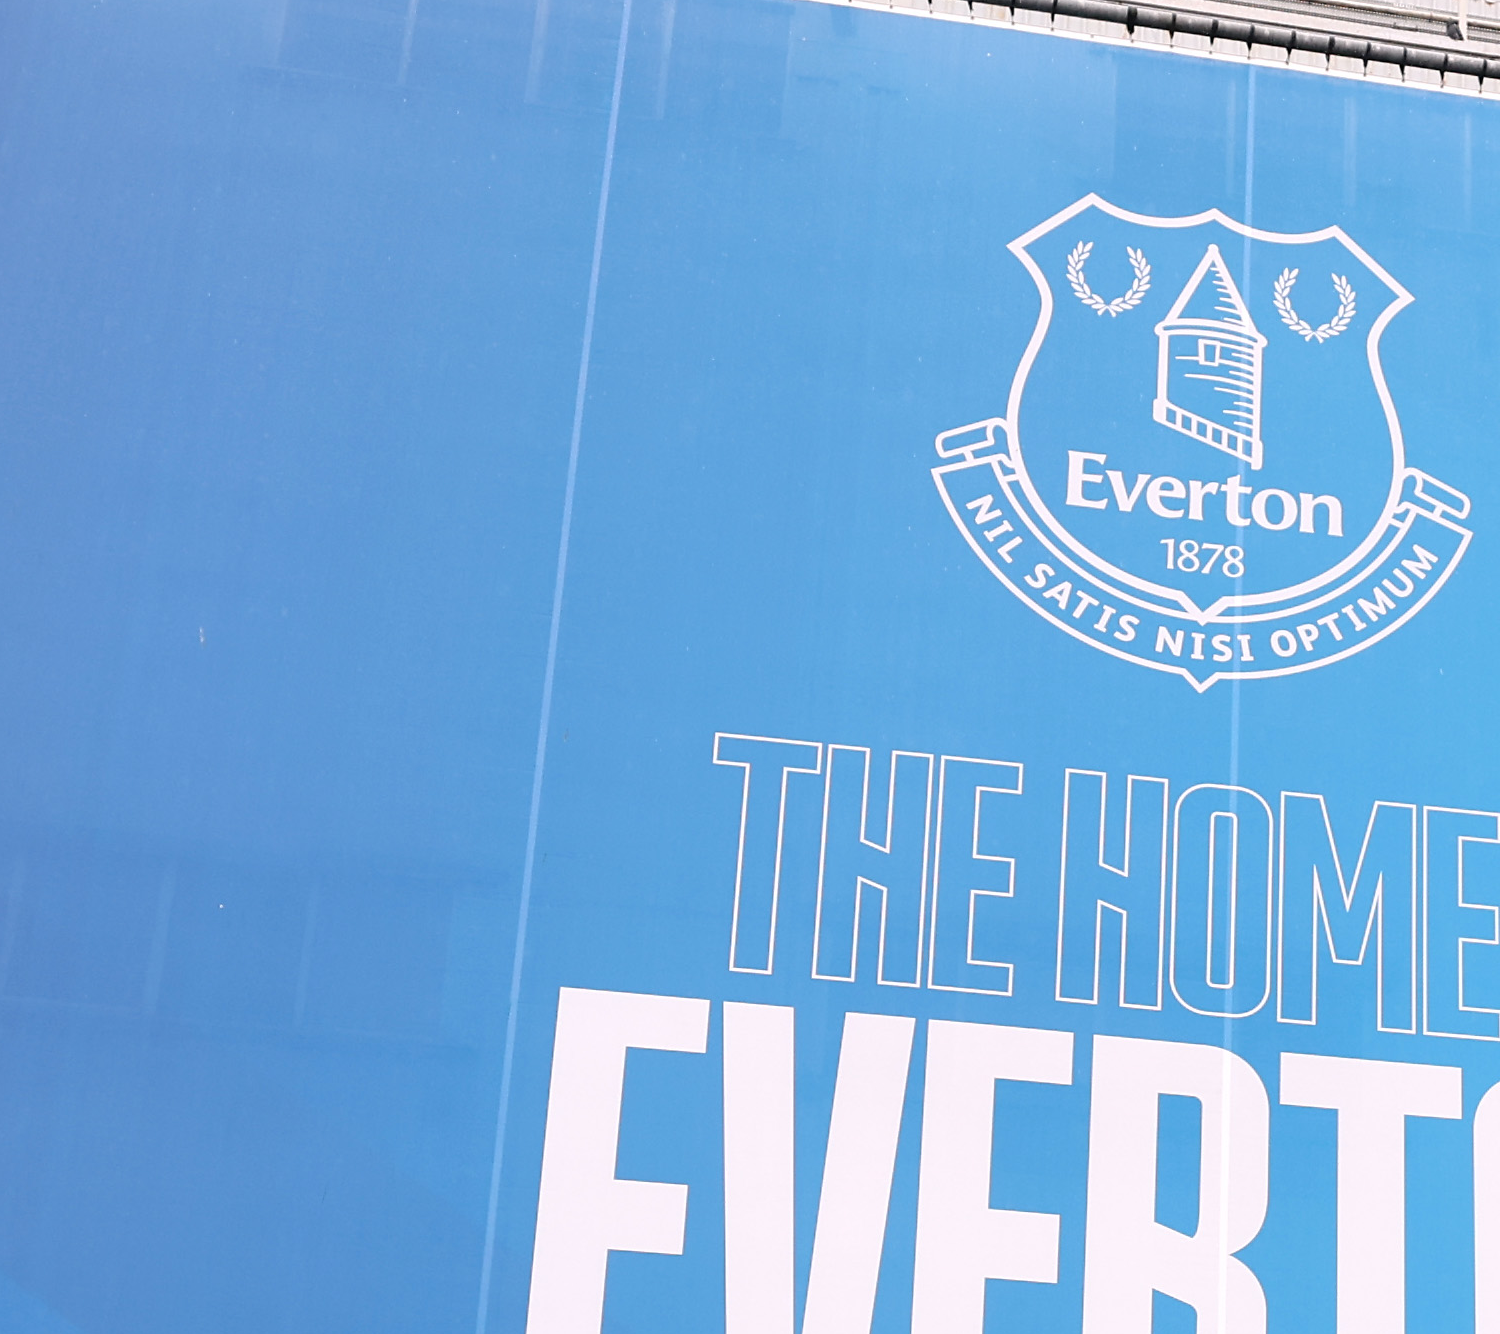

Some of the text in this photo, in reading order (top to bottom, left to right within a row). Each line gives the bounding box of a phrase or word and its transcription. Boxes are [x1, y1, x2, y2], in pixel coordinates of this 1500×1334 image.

[1064, 450, 1345, 537] Everton
[966, 492, 1439, 662] NIL SATIS NISI OPTIMUM
[1159, 538, 1245, 578] 1878
[712, 732, 1023, 996] THE
